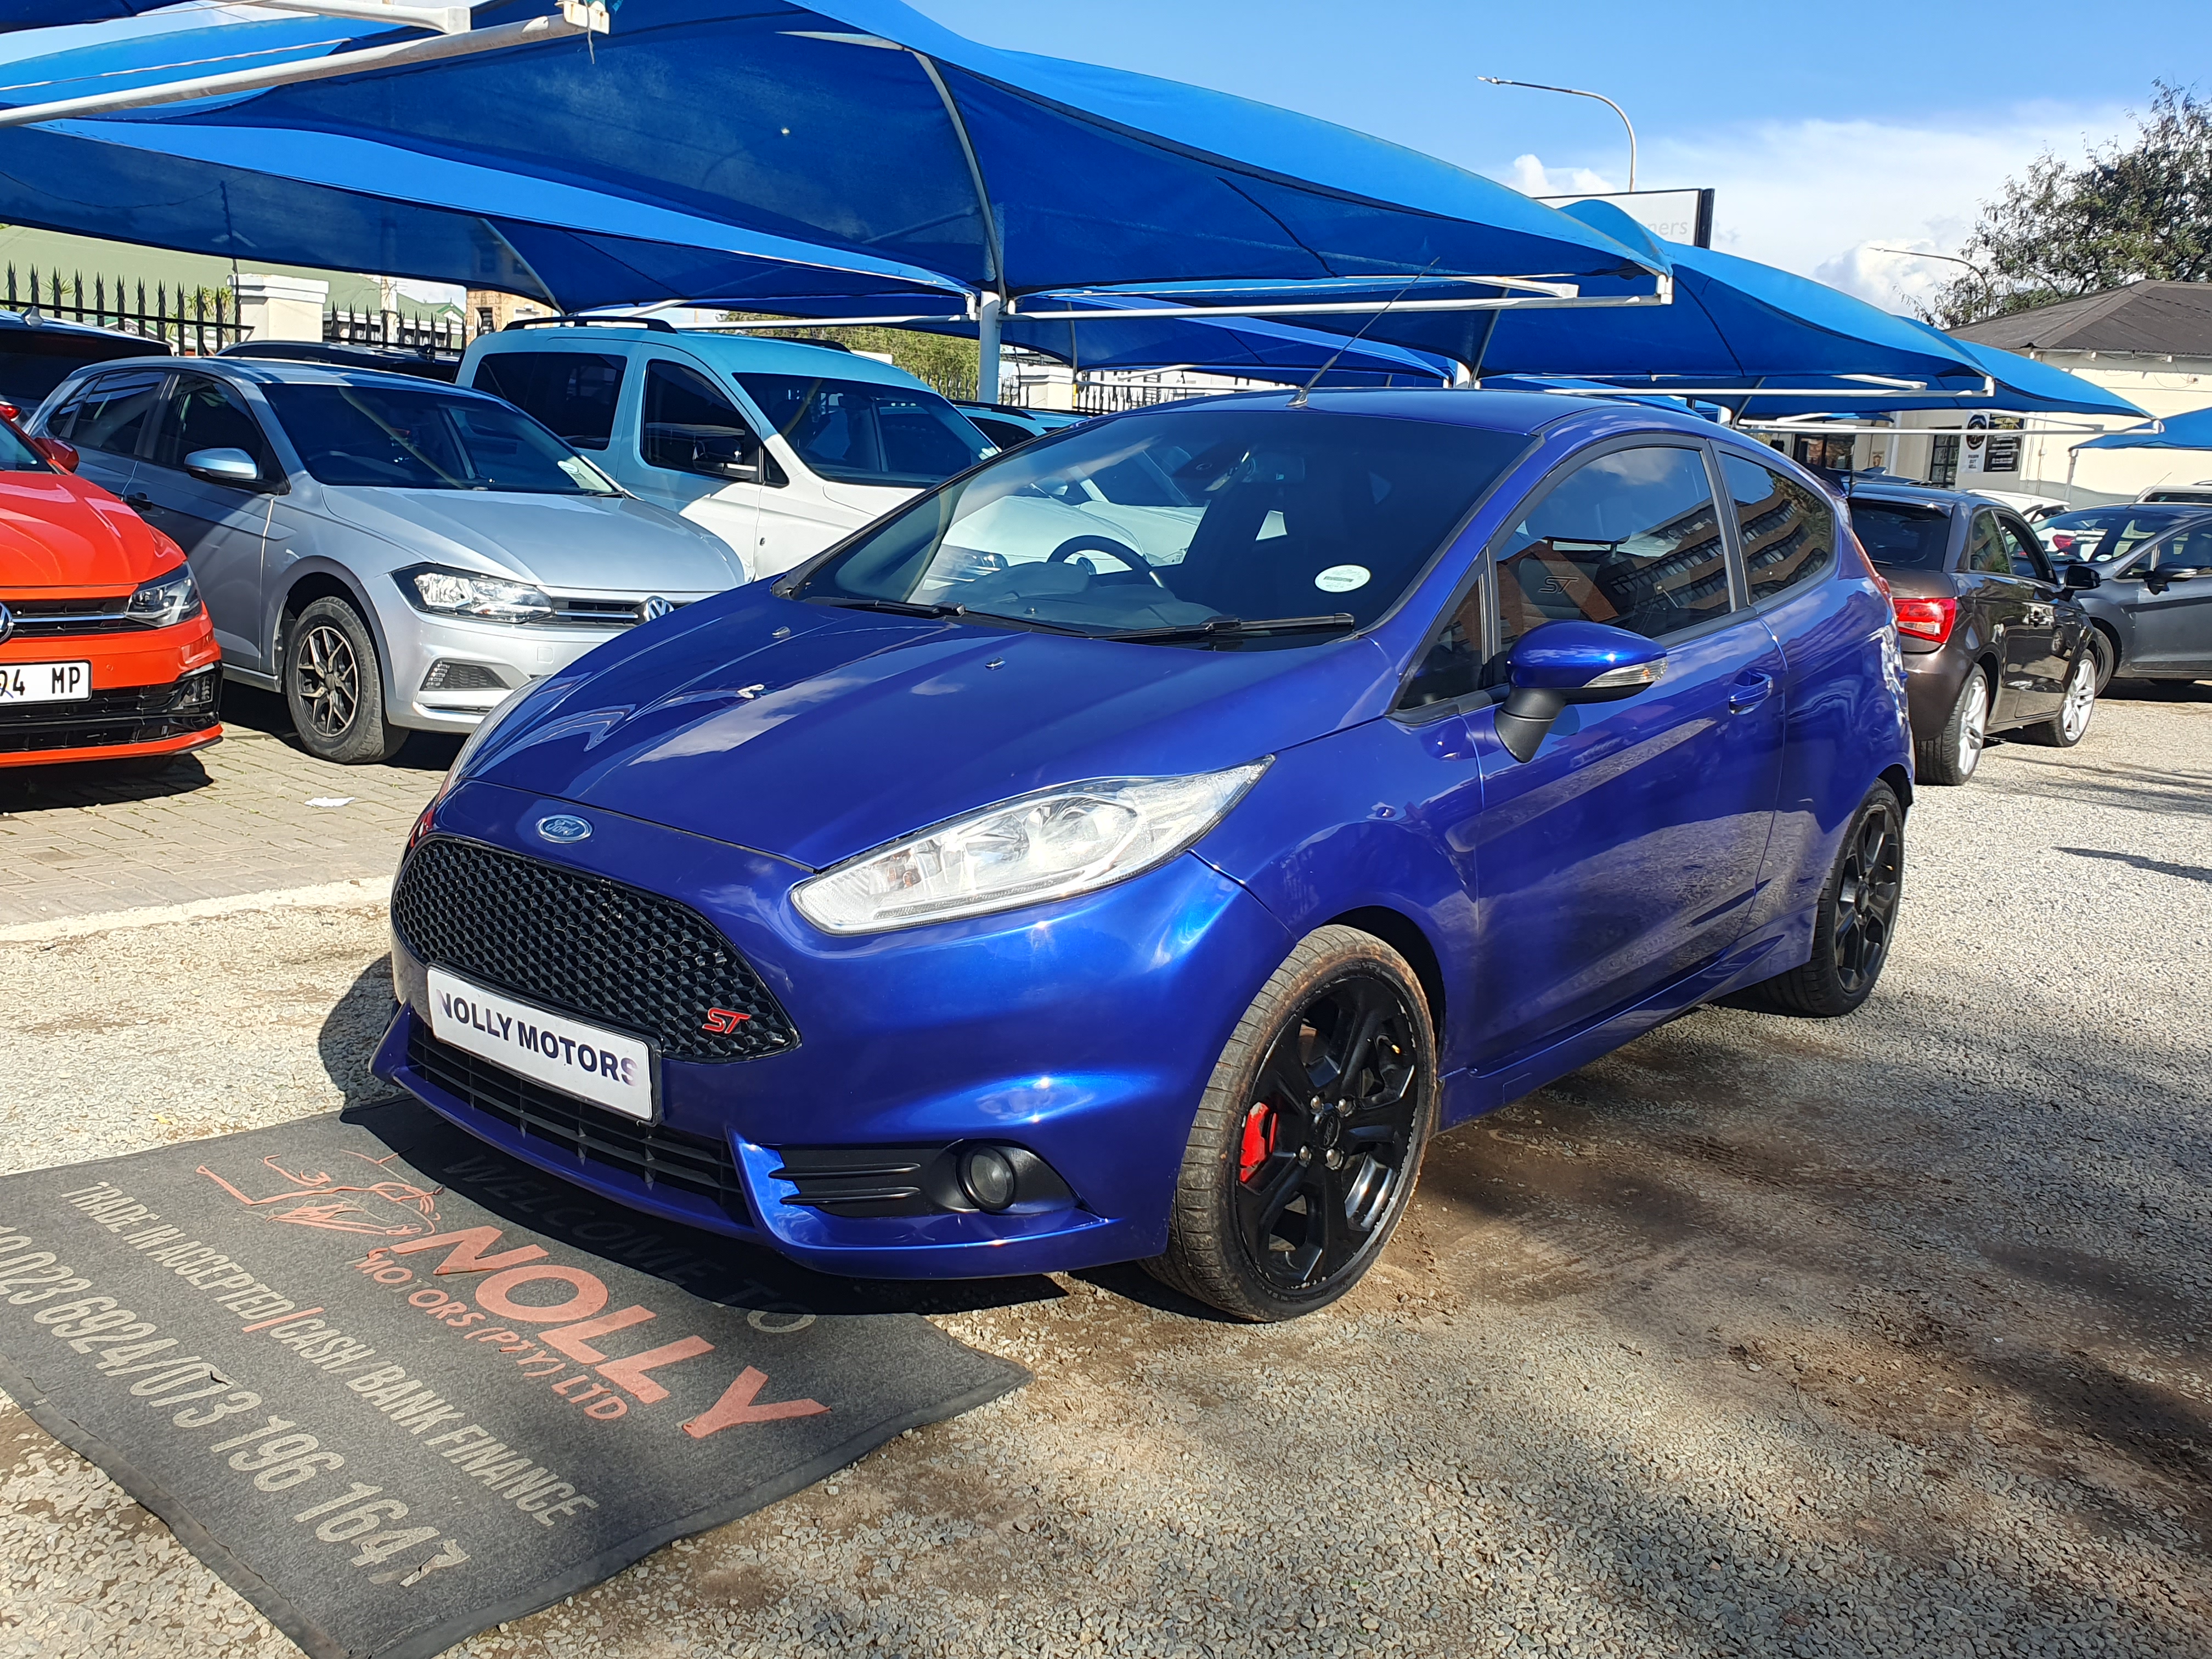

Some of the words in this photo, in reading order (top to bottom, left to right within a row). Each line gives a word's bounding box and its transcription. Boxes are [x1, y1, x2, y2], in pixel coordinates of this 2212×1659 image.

[52, 667, 81, 694] MP
[545, 819, 580, 836] Ford
[436, 989, 512, 1041] NOLLY
[517, 1020, 638, 1087] MOTORS
[702, 1007, 752, 1034] ST
[61, 1182, 161, 1233] TRADE
[122, 1223, 187, 1250] IN
[442, 1154, 727, 1285] WELCOME
[718, 1277, 817, 1334] TO
[146, 1240, 295, 1320] ACCEPTED
[355, 1248, 486, 1326] MOTORS
[464, 1327, 567, 1377] (PTY)
[551, 1374, 628, 1420] LTD
[390, 1225, 832, 1438] NOLLY
[210, 1414, 345, 1492] 196
[423, 1424, 600, 1527] FINANCE
